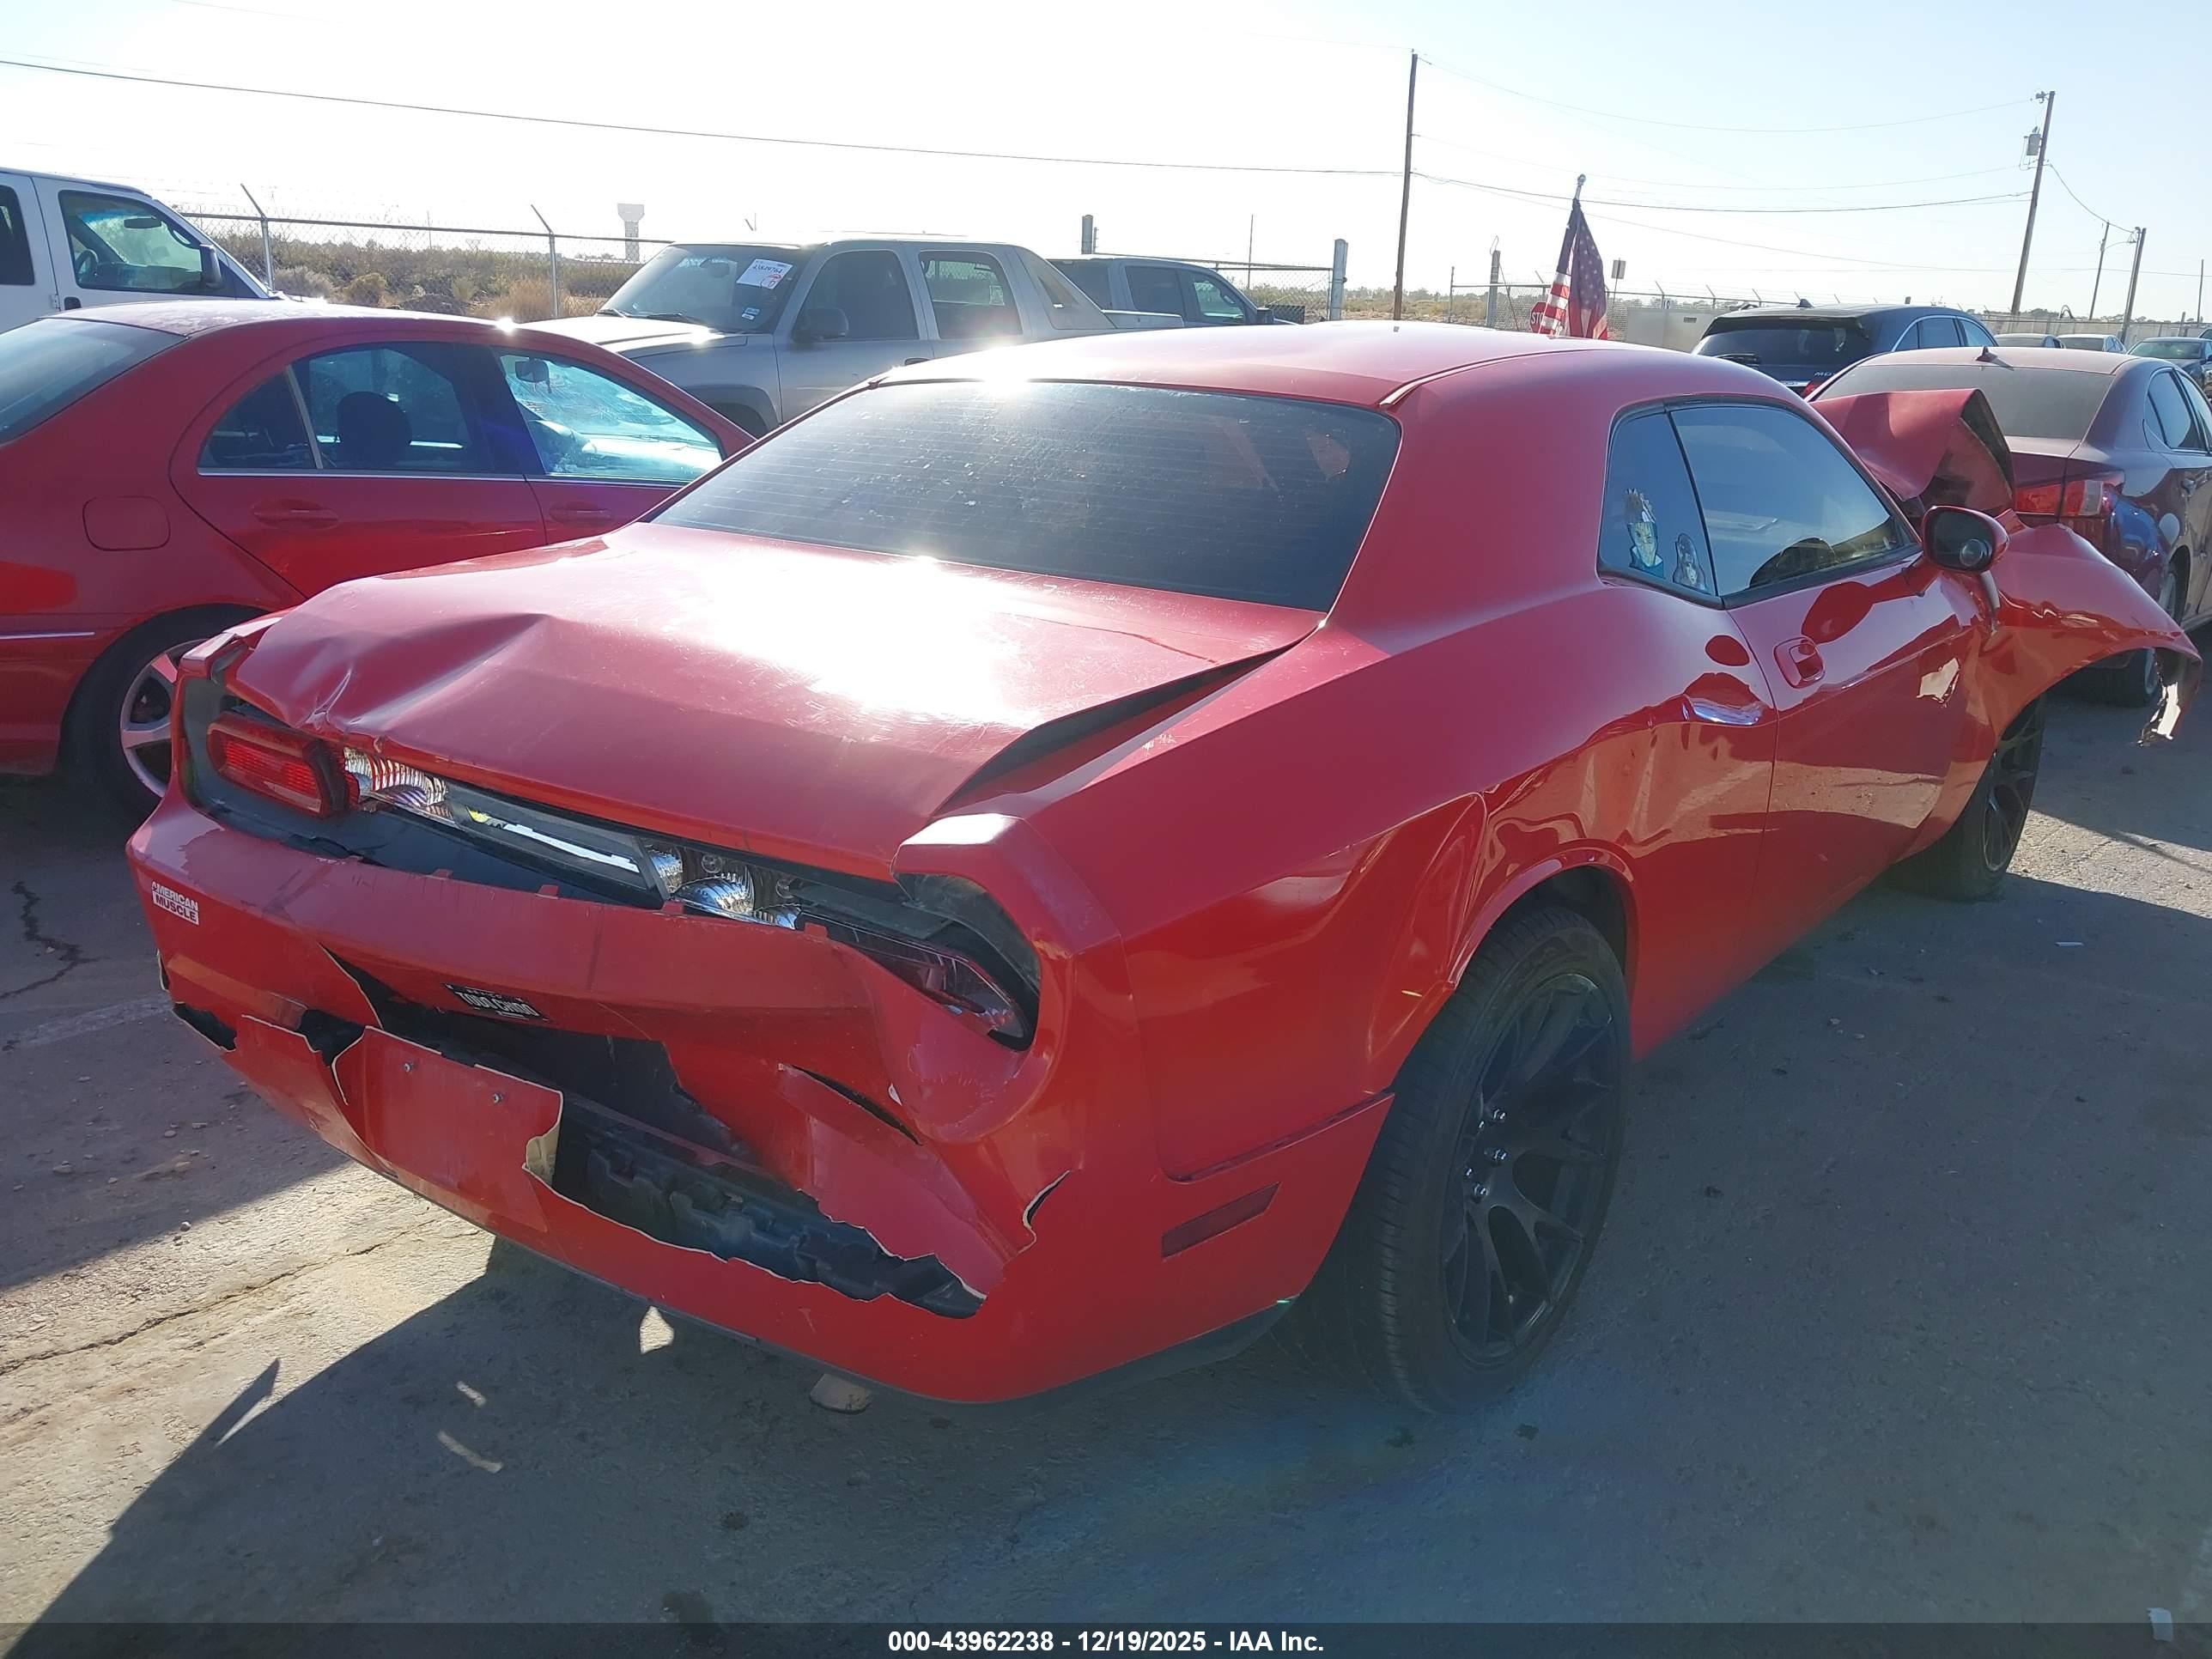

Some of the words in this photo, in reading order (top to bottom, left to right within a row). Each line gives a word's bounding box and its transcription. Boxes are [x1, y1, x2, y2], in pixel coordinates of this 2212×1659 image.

[1531, 312, 1546, 325] STO
[151, 880, 198, 911] AMERICAN
[155, 892, 198, 921] MUSCLE
